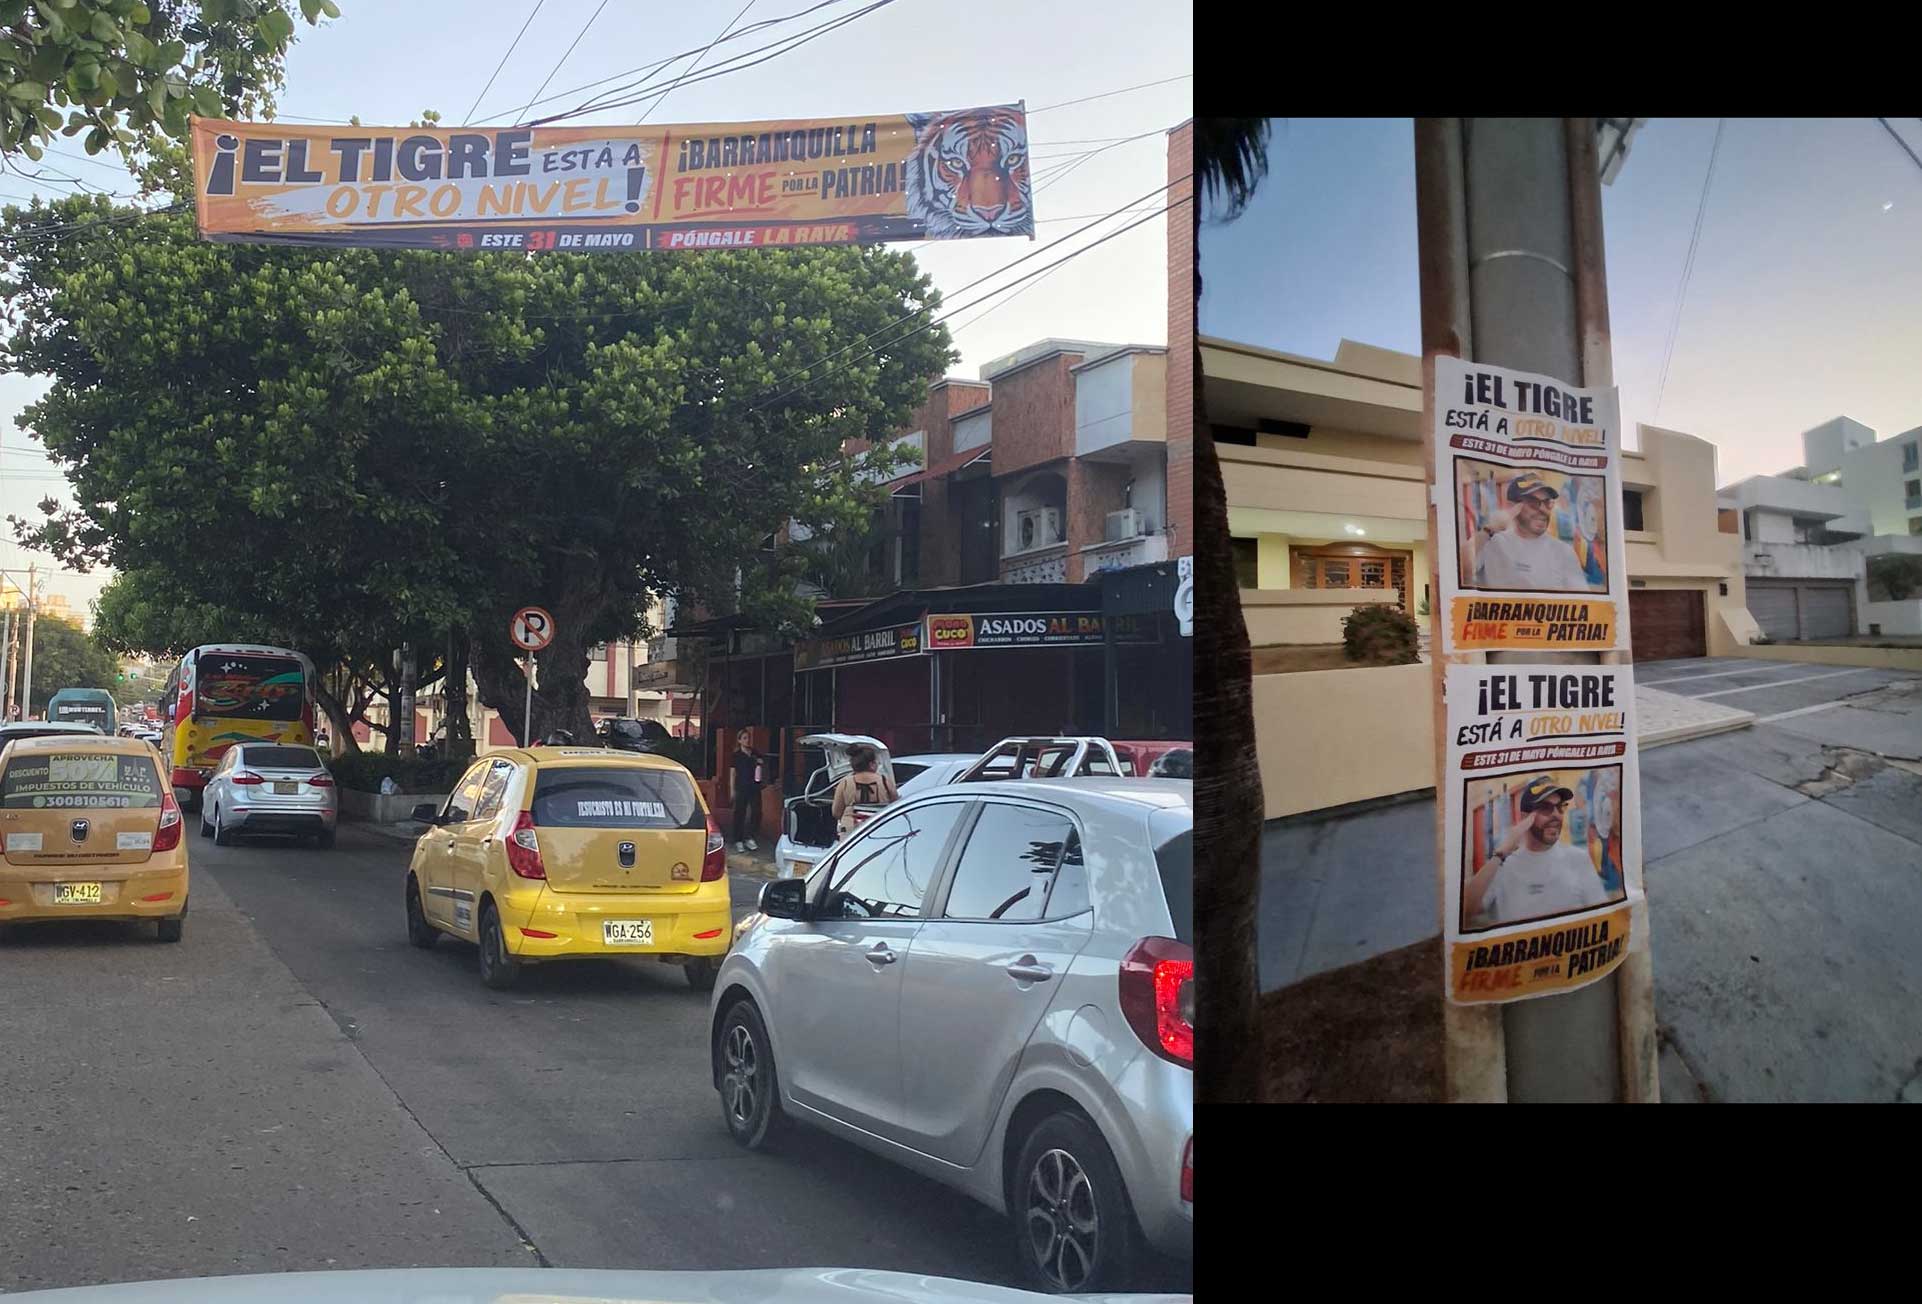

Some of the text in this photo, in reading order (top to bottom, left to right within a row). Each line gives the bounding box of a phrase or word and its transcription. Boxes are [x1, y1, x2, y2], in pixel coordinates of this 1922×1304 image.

[678, 123, 877, 172] ¡BARRANQUILLA
[206, 131, 641, 196] ¡EL TIGRE ESTÁ A
[326, 167, 646, 219] OTRO NIVEL!
[673, 161, 907, 210] FIRME POR LA PATRIA!
[481, 225, 849, 250] ESTE 31 DE MAYO PÓNGALE LA RAYA
[1465, 373, 1594, 424] ¡EL TIGRE
[1445, 409, 1605, 445] ESTÁ A OTRO NIVEL!
[1462, 437, 1484, 450] ESTE
[1485, 441, 1496, 452] 31
[1496, 443, 1507, 454] DE
[1508, 446, 1532, 458] MAYO
[1568, 454, 1577, 465] LA
[980, 619, 1047, 634] ASADOS
[1050, 618, 1069, 634] AL
[1467, 602, 1589, 623] ¡BARRANQUILLA
[851, 635, 862, 652] AL
[864, 631, 896, 651] BARRIL
[935, 629, 967, 640] CUCO
[1516, 628, 1531, 636] POR
[1532, 628, 1541, 636] LA
[1547, 623, 1608, 641] PATRIA!
[1478, 674, 1615, 715] ¡EL TIGRE
[1457, 712, 1625, 746] ESTÁ A OTRO NIVEL!
[1473, 753, 1496, 767] ESTE
[1497, 752, 1509, 764] 31
[1510, 751, 1521, 763] DE
[1521, 749, 1546, 761] MAYO
[1586, 745, 1596, 756] LA
[9, 767, 49, 779] DESCUENTO
[15, 781, 151, 793] IMPUESTOS DE VEHÍCULO
[614, 801, 623, 816] ES
[1466, 920, 1609, 971] ¡BARRANQUILLA
[1459, 965, 1523, 992] FIRME
[1568, 934, 1625, 979] PATRIA!
